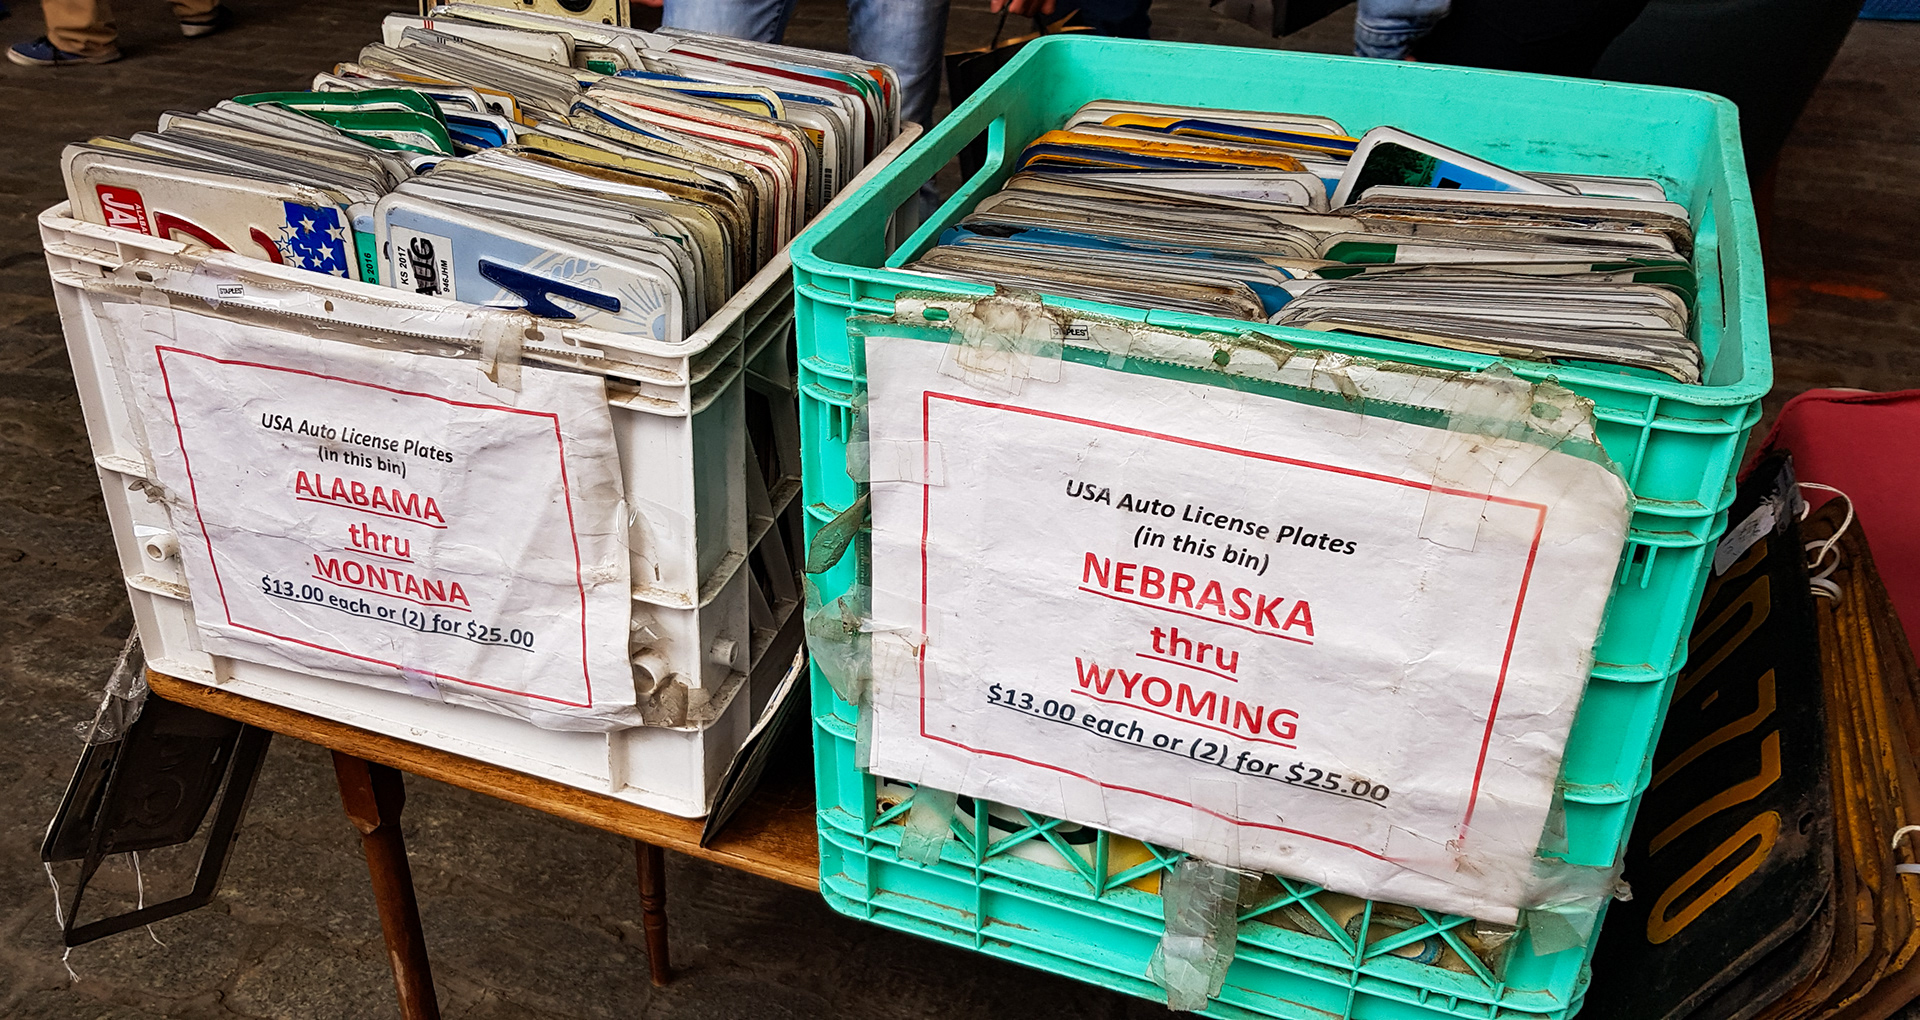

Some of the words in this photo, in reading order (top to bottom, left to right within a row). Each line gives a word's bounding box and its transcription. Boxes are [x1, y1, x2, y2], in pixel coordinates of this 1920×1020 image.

[364, 253, 375, 275] 2016
[397, 246, 407, 268] 2017
[400, 271, 409, 285] KS
[440, 260, 450, 292] 946JHM
[261, 413, 293, 433] USA
[298, 420, 336, 440] Auto
[341, 427, 399, 452] License
[404, 439, 453, 463] Plates
[318, 445, 338, 462] (in
[343, 451, 373, 468] this
[377, 457, 406, 479] bin)
[295, 470, 446, 524] ALABAMA
[1066, 479, 1111, 506] USA
[1116, 493, 1176, 518] Auto
[1182, 504, 1270, 540] License
[1276, 525, 1358, 556] Plates
[348, 523, 411, 559] thru
[1133, 525, 1166, 548] (in
[1173, 534, 1216, 559] this
[1222, 544, 1270, 577] bin)
[313, 554, 471, 607] MONTANA
[1082, 551, 1315, 638] NEBRASKA
[261, 574, 324, 602] $13.00
[328, 593, 371, 615] each
[377, 605, 396, 620] or
[401, 607, 426, 631] (2)
[432, 613, 462, 634] for
[467, 620, 535, 648] $25.00
[1150, 626, 1239, 674] thru
[1074, 656, 1300, 741] WYOMING
[987, 683, 1076, 722] $13.00
[1081, 712, 1145, 743] each
[1152, 732, 1183, 751] or
[1189, 737, 1228, 767] (2)
[1236, 750, 1280, 776] for
[1285, 761, 1390, 802] $25.00
